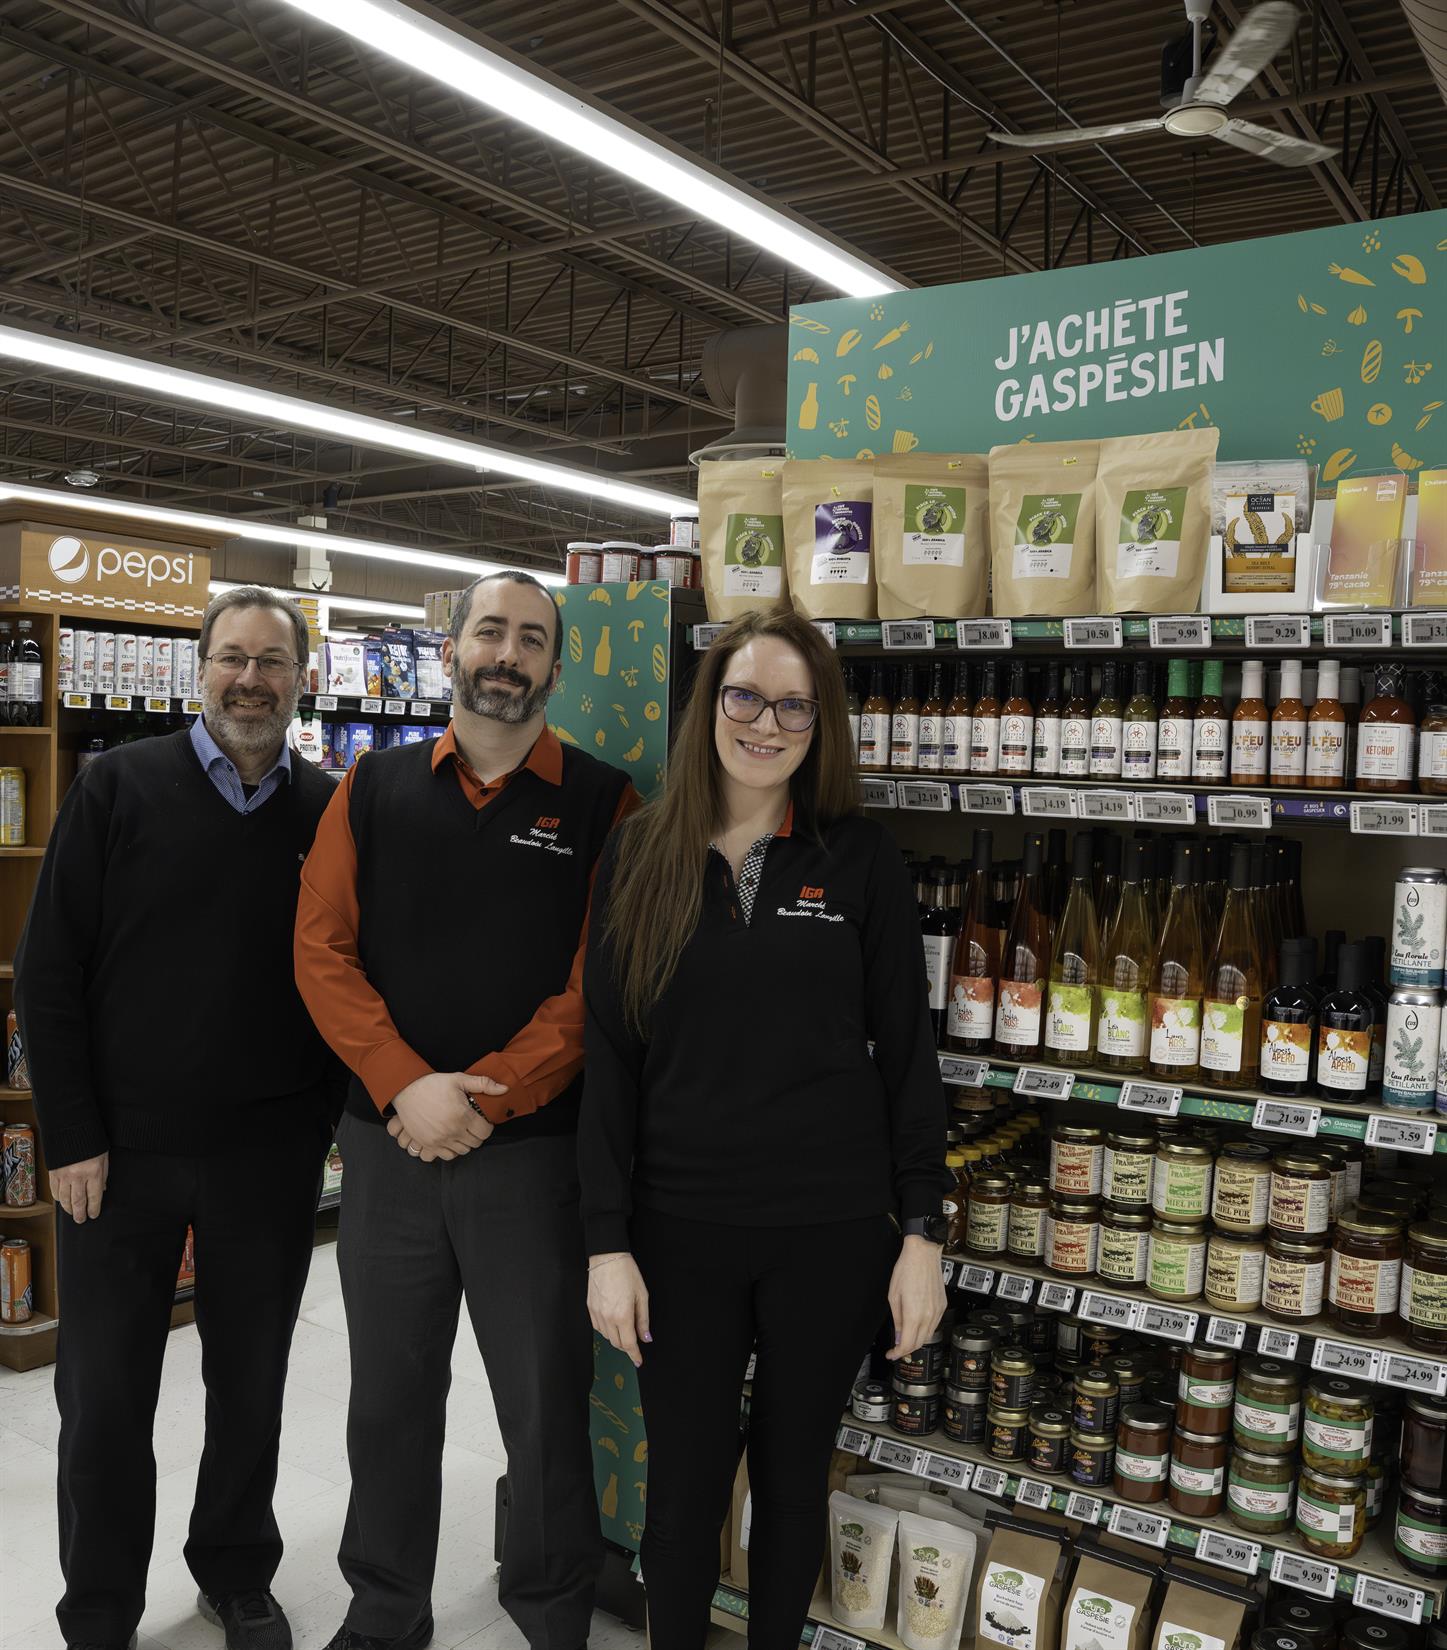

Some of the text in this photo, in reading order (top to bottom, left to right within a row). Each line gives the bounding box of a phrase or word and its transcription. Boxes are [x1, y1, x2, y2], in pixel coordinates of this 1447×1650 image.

[97, 548, 194, 588] pepsi
[902, 632, 923, 641] 18.00
[978, 631, 1000, 640] 18.00
[1086, 630, 1109, 639] 10.50
[1178, 629, 1198, 638] 9.99
[1276, 629, 1296, 638] 9.29
[1350, 628, 1377, 637] 10.09
[1234, 736, 1264, 746] L'FEU
[1272, 736, 1302, 746] L'FEU
[1312, 736, 1342, 747] L'FEU
[1366, 745, 1395, 756] KETCHUP
[918, 794, 939, 803] 12.19
[980, 796, 1002, 805] 12.19
[1043, 799, 1066, 809] 14.19
[1100, 802, 1123, 812] 14.19
[1158, 805, 1182, 815] 19.99
[1232, 809, 1257, 819] 10.99
[535, 816, 561, 828] IGA
[1376, 815, 1404, 826] 21.99
[799, 886, 824, 899] IGA
[1108, 1029, 1130, 1039] BLANC
[952, 1067, 975, 1077] 22.49
[1036, 1079, 1060, 1089] 22.49
[1143, 1094, 1168, 1105] 22.49
[1278, 1112, 1305, 1125] 21.99
[1398, 1131, 1421, 1143] 3.59
[1055, 1177, 1089, 1188] MIEL PUR
[1112, 1186, 1147, 1197] MIEL PUR
[1166, 1199, 1202, 1209] MIEL PUR
[1216, 1205, 1250, 1218] MIEL PUR
[1271, 1212, 1304, 1225] MIEL PUR
[1054, 1255, 1069, 1264] MIEL
[1101, 1262, 1134, 1274] MIEL PUR
[1152, 1274, 1185, 1287] MIEL PUR
[1220, 1285, 1236, 1295] PUR
[1267, 1293, 1301, 1308] MIEL PUR
[1338, 1292, 1374, 1306] MIEL PUR
[1102, 1305, 1126, 1318] 13.99
[1410, 1306, 1429, 1318] MIEL
[1159, 1318, 1184, 1331] 13.99
[1338, 1354, 1365, 1368] 24.99
[1405, 1368, 1432, 1382] 24.99
[894, 1453, 911, 1464] 8.29
[943, 1467, 961, 1479] 8.29
[1136, 1522, 1156, 1534] 8.29
[1226, 1548, 1246, 1561] 9.99
[997, 1573, 1018, 1587] Pure
[1302, 1569, 1323, 1583] 9.99
[1386, 1594, 1408, 1609] 9.99
[1085, 1600, 1106, 1615] Pure
[1172, 1636, 1196, 1650] Pure
